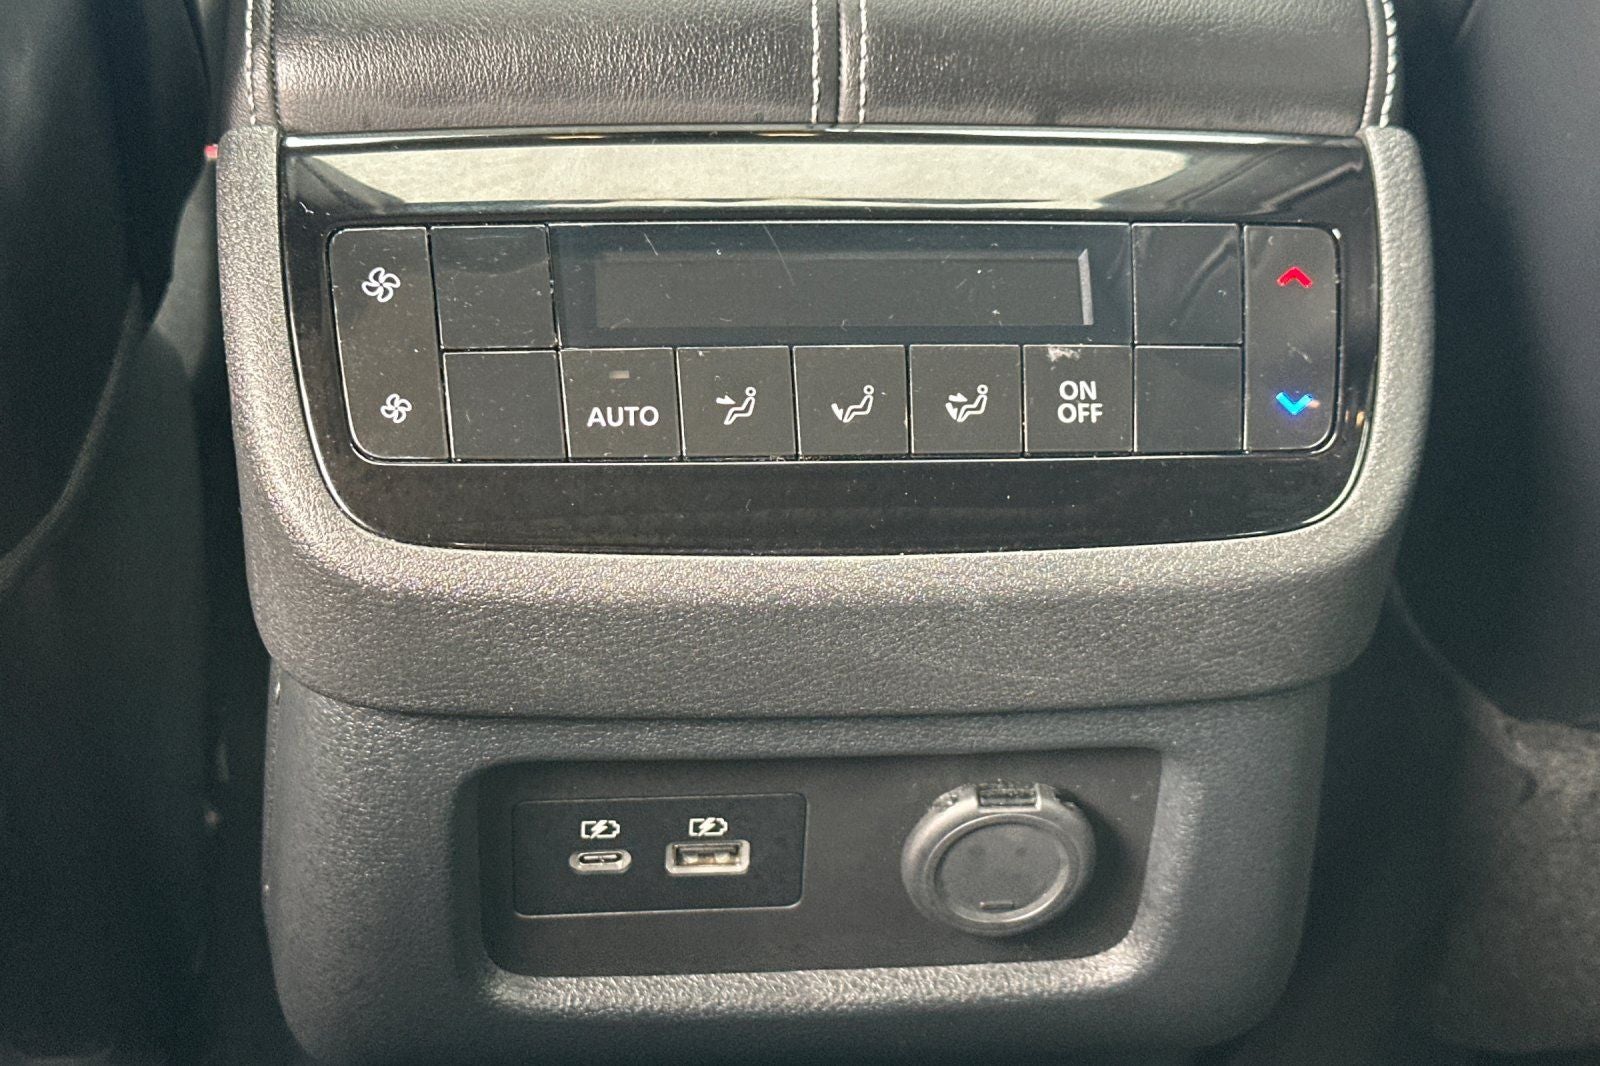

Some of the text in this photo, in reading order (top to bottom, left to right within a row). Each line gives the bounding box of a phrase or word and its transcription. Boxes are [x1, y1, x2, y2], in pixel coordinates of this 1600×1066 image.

[1058, 380, 1098, 401] ON
[586, 405, 660, 428] AUTO
[1057, 402, 1103, 424] OFF
